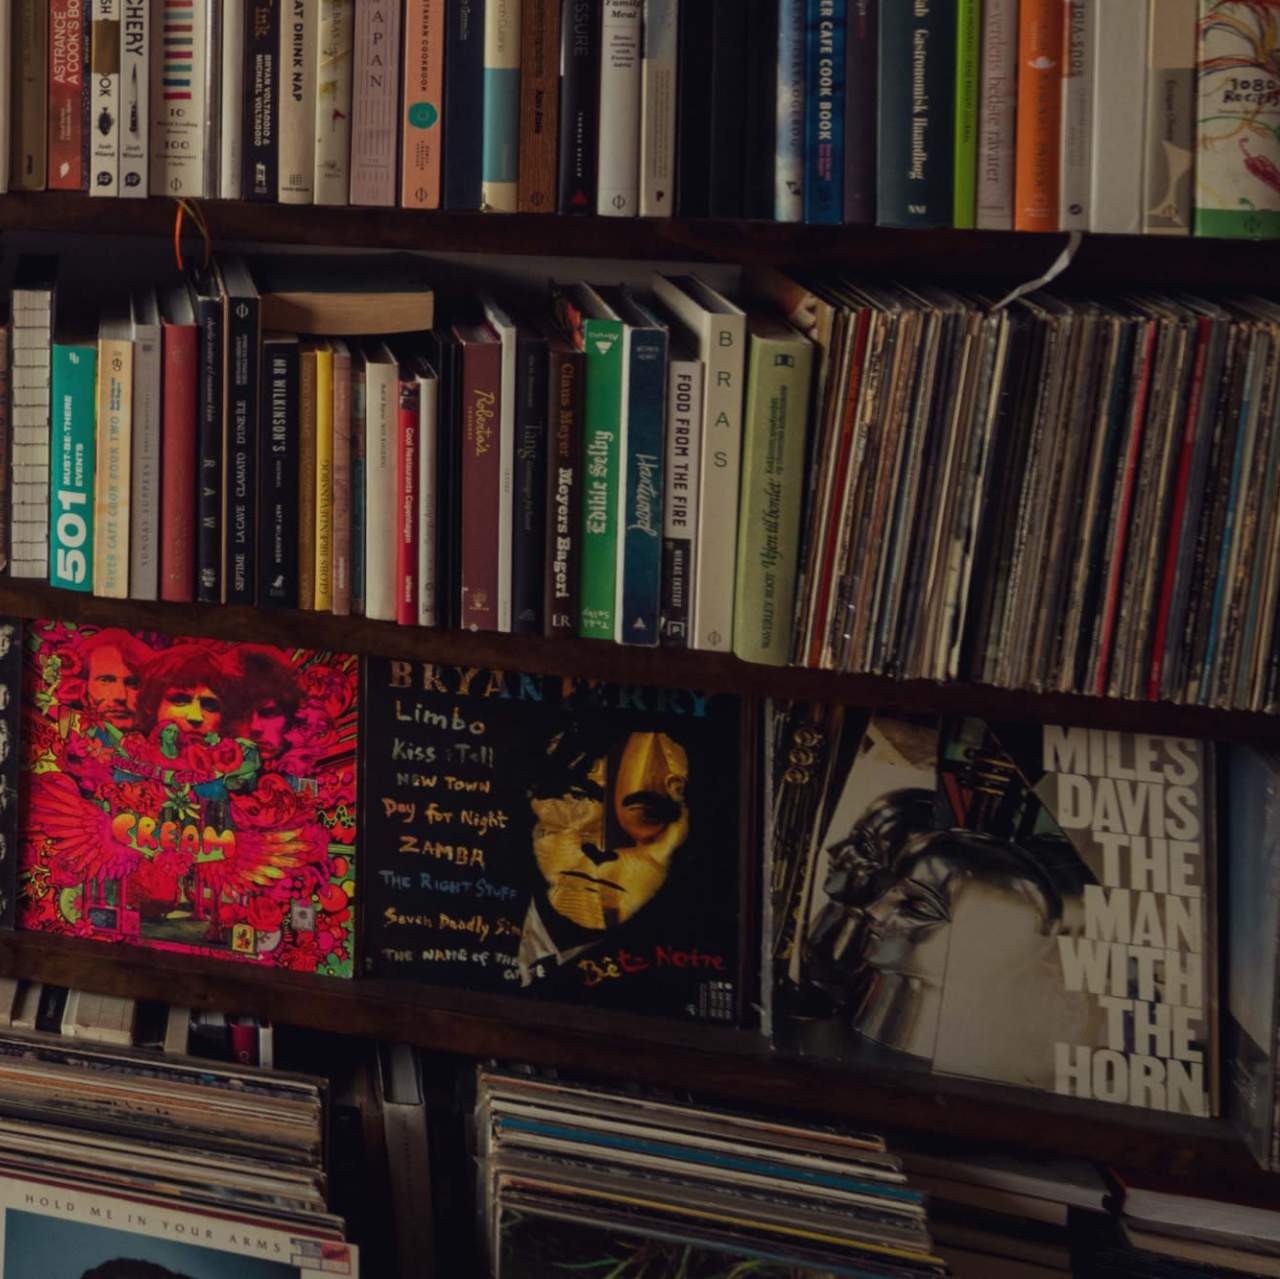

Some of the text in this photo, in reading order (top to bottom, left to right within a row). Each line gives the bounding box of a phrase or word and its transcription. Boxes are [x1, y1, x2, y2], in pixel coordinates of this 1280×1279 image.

[53, 11, 66, 84] ASTRANCE
[67, 20, 80, 73] COOK'S
[291, 23, 304, 67] DRINK
[419, 39, 429, 92] COOKBOOK
[819, 21, 834, 54] CAFE
[253, 53, 263, 147] MICHAEL VOLTAGGIO
[291, 72, 303, 103] NAP
[819, 58, 834, 97] COOK
[1230, 78, 1277, 91] 1080
[818, 101, 833, 140] BOOK
[272, 358, 288, 453] MR WILKINSON'S
[473, 388, 496, 457] Roberta's
[558, 363, 575, 458] Claus Meyer
[714, 330, 734, 470] BRAS
[62, 394, 73, 486] MUST-BE-THERE
[74, 442, 85, 487] EVENTS
[517, 421, 544, 463] Tang
[673, 373, 692, 528] FOOD FROM THE FIRE
[403, 427, 415, 544] Cool Restaurants Copenhagen
[586, 430, 615, 535] Edible Selby
[55, 488, 87, 585] 501
[274, 503, 283, 564] MATT WILKINSON
[553, 467, 573, 599] Meyers Bageri
[672, 548, 682, 609] NIKLAS EKSTEDT
[395, 700, 487, 736] Limbo
[391, 737, 496, 768] Kiss Tell
[1042, 723, 1201, 786] MILES
[111, 812, 237, 861] CREAM
[382, 797, 510, 837] Day for Night
[1056, 773, 1202, 842] DAVIS
[398, 835, 486, 868] ZAMBA
[1091, 830, 1202, 898] THE
[1083, 883, 1203, 953] MAN
[1056, 934, 1204, 1008] WITH
[1097, 994, 1205, 1064] THE
[1052, 1041, 1210, 1119] HORN
[24, 1192, 283, 1255] HOLD ME IN YOUR ARMS
